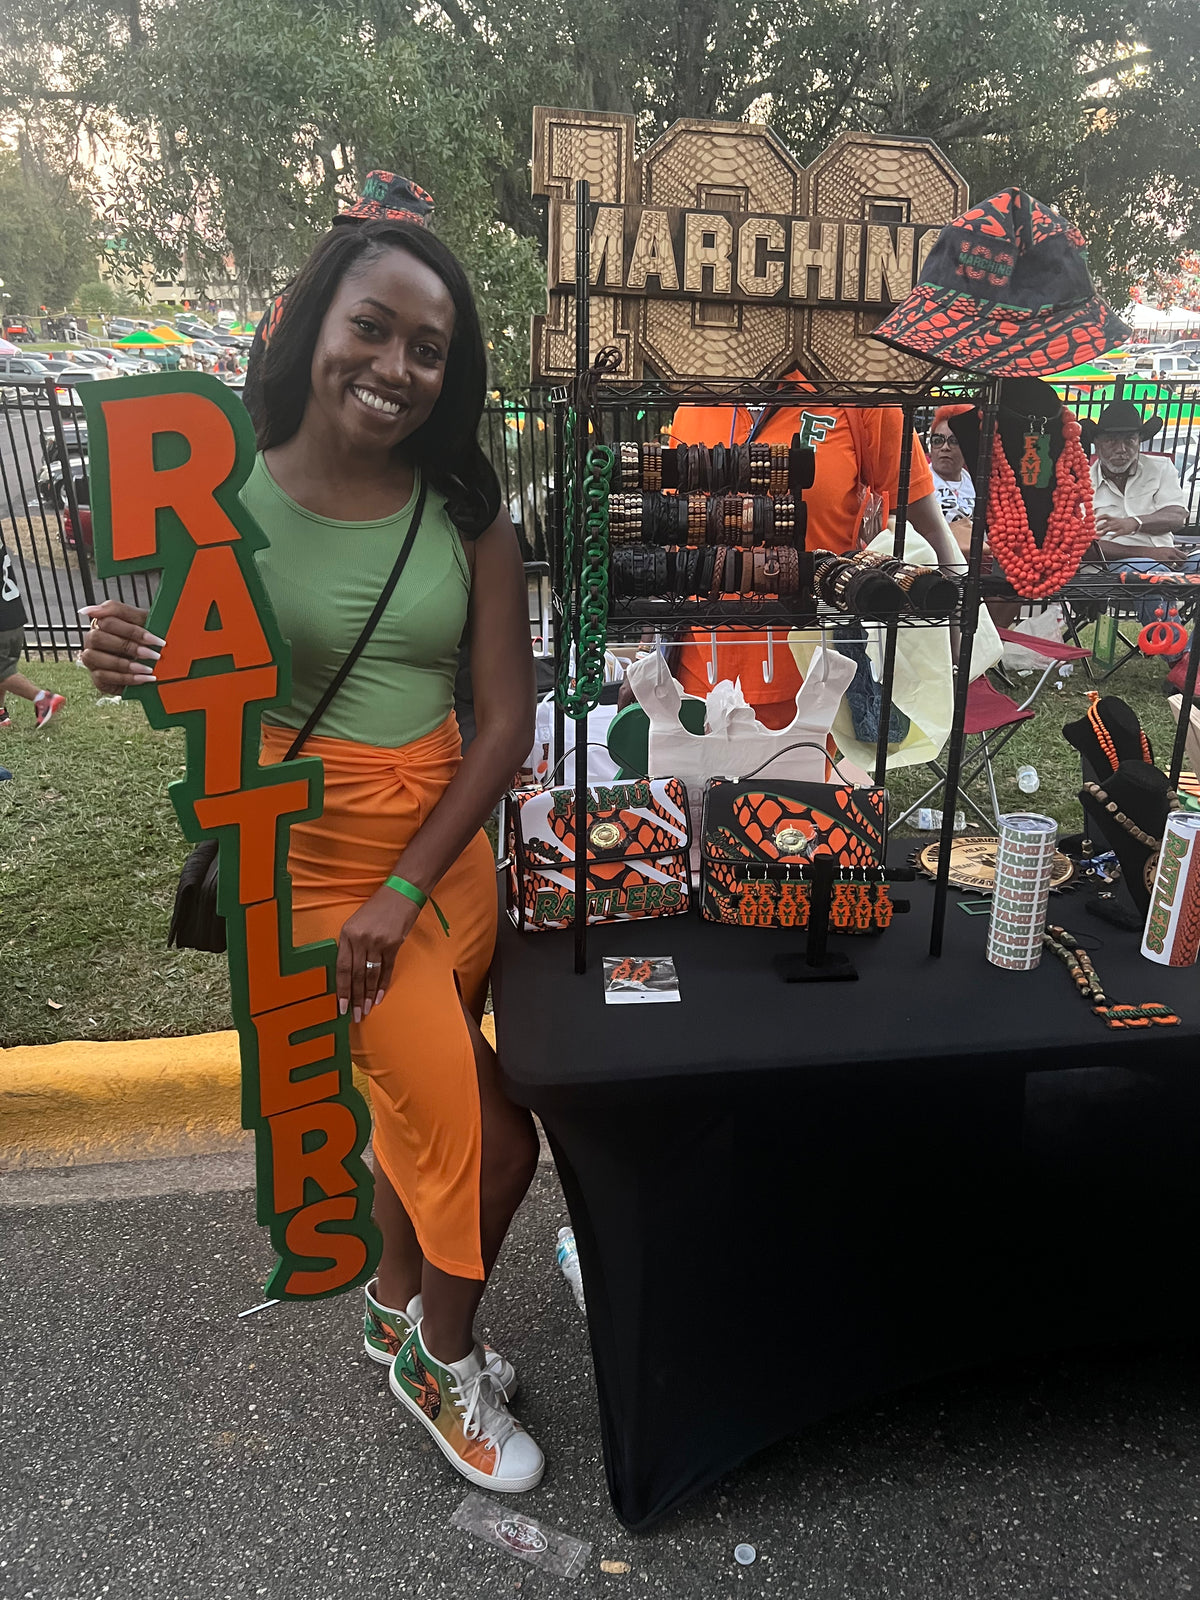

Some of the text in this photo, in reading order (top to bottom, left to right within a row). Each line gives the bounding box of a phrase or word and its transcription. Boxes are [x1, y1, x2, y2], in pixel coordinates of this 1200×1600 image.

[959, 252, 1013, 277] MARCHING
[1021, 436, 1041, 486] FAMU
[101, 392, 368, 1295] RATTLERS
[739, 883, 758, 926] FAMU
[758, 883, 774, 926] FAMU
[778, 884, 797, 927] FAMU
[831, 884, 850, 927] FAMU
[856, 885, 872, 929] FAMU
[874, 884, 893, 928] FAMU
[1146, 829, 1190, 955] RATTLERS
